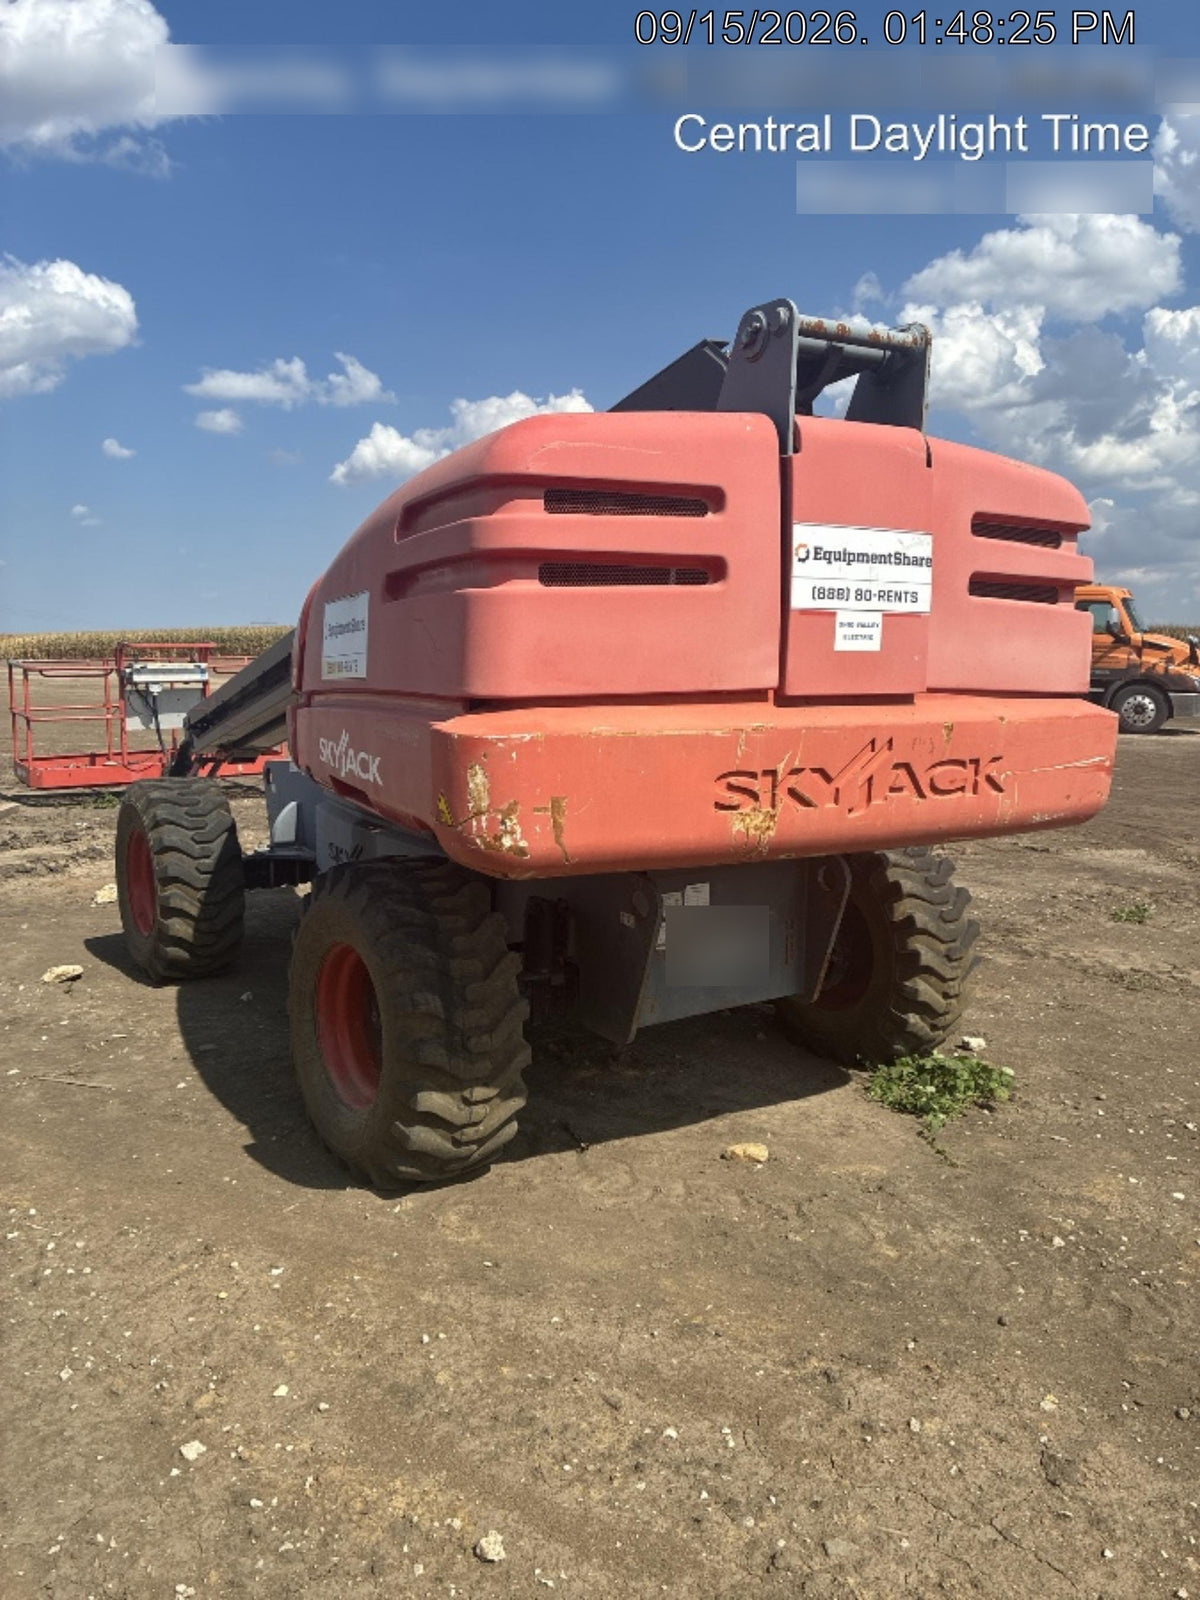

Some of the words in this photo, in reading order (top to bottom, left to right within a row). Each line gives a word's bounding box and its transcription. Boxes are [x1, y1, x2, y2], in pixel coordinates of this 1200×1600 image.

[813, 546, 932, 568] EquipmentShare
[854, 588, 918, 603] 80-RENTS
[319, 729, 383, 786] SKYJACK
[713, 737, 1004, 817] SKYJACK
